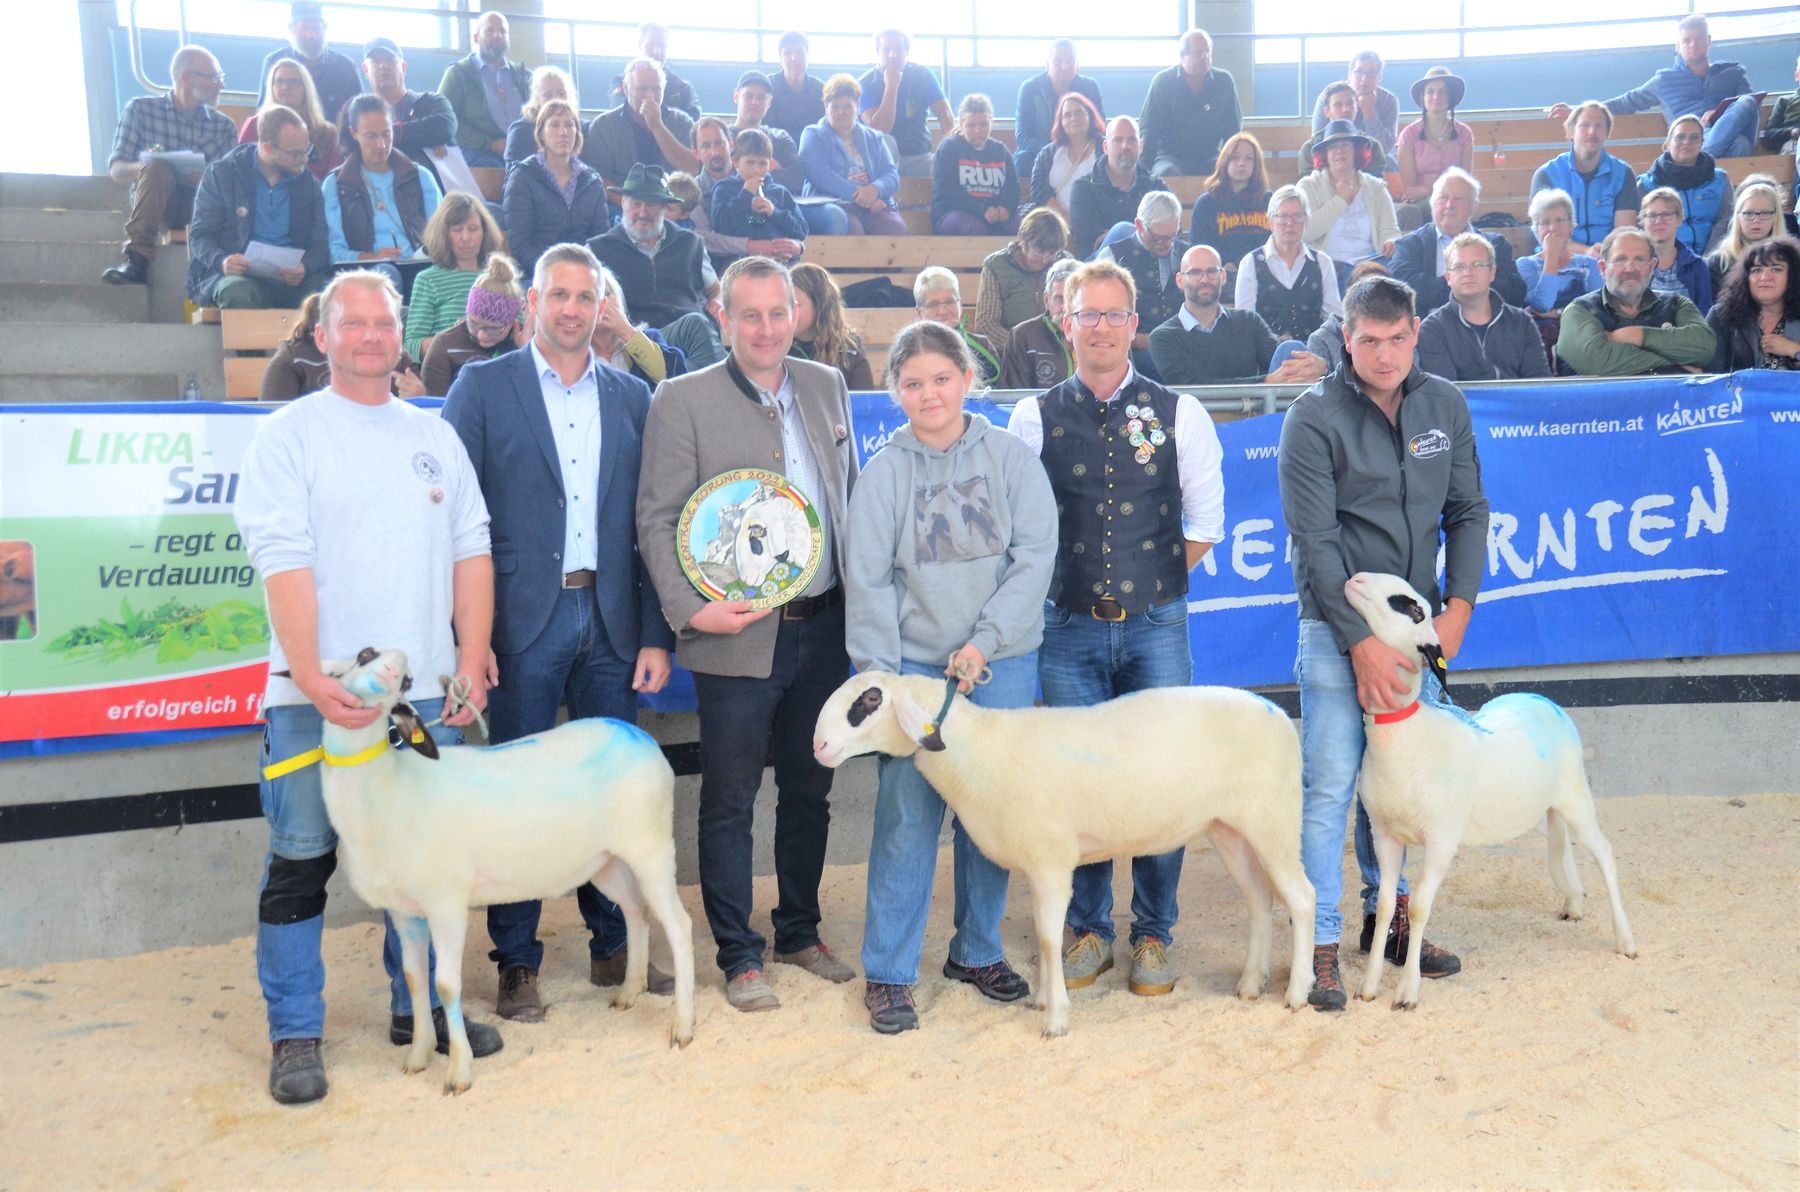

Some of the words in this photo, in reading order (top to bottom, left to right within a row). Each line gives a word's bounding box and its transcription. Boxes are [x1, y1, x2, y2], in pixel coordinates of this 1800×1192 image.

[959, 165, 1006, 188] RUN
[1489, 415, 1644, 438] www.kaernten.at
[154, 530, 216, 557] regt
[99, 562, 256, 589] Verdauung
[108, 694, 237, 720] erfolgreich
